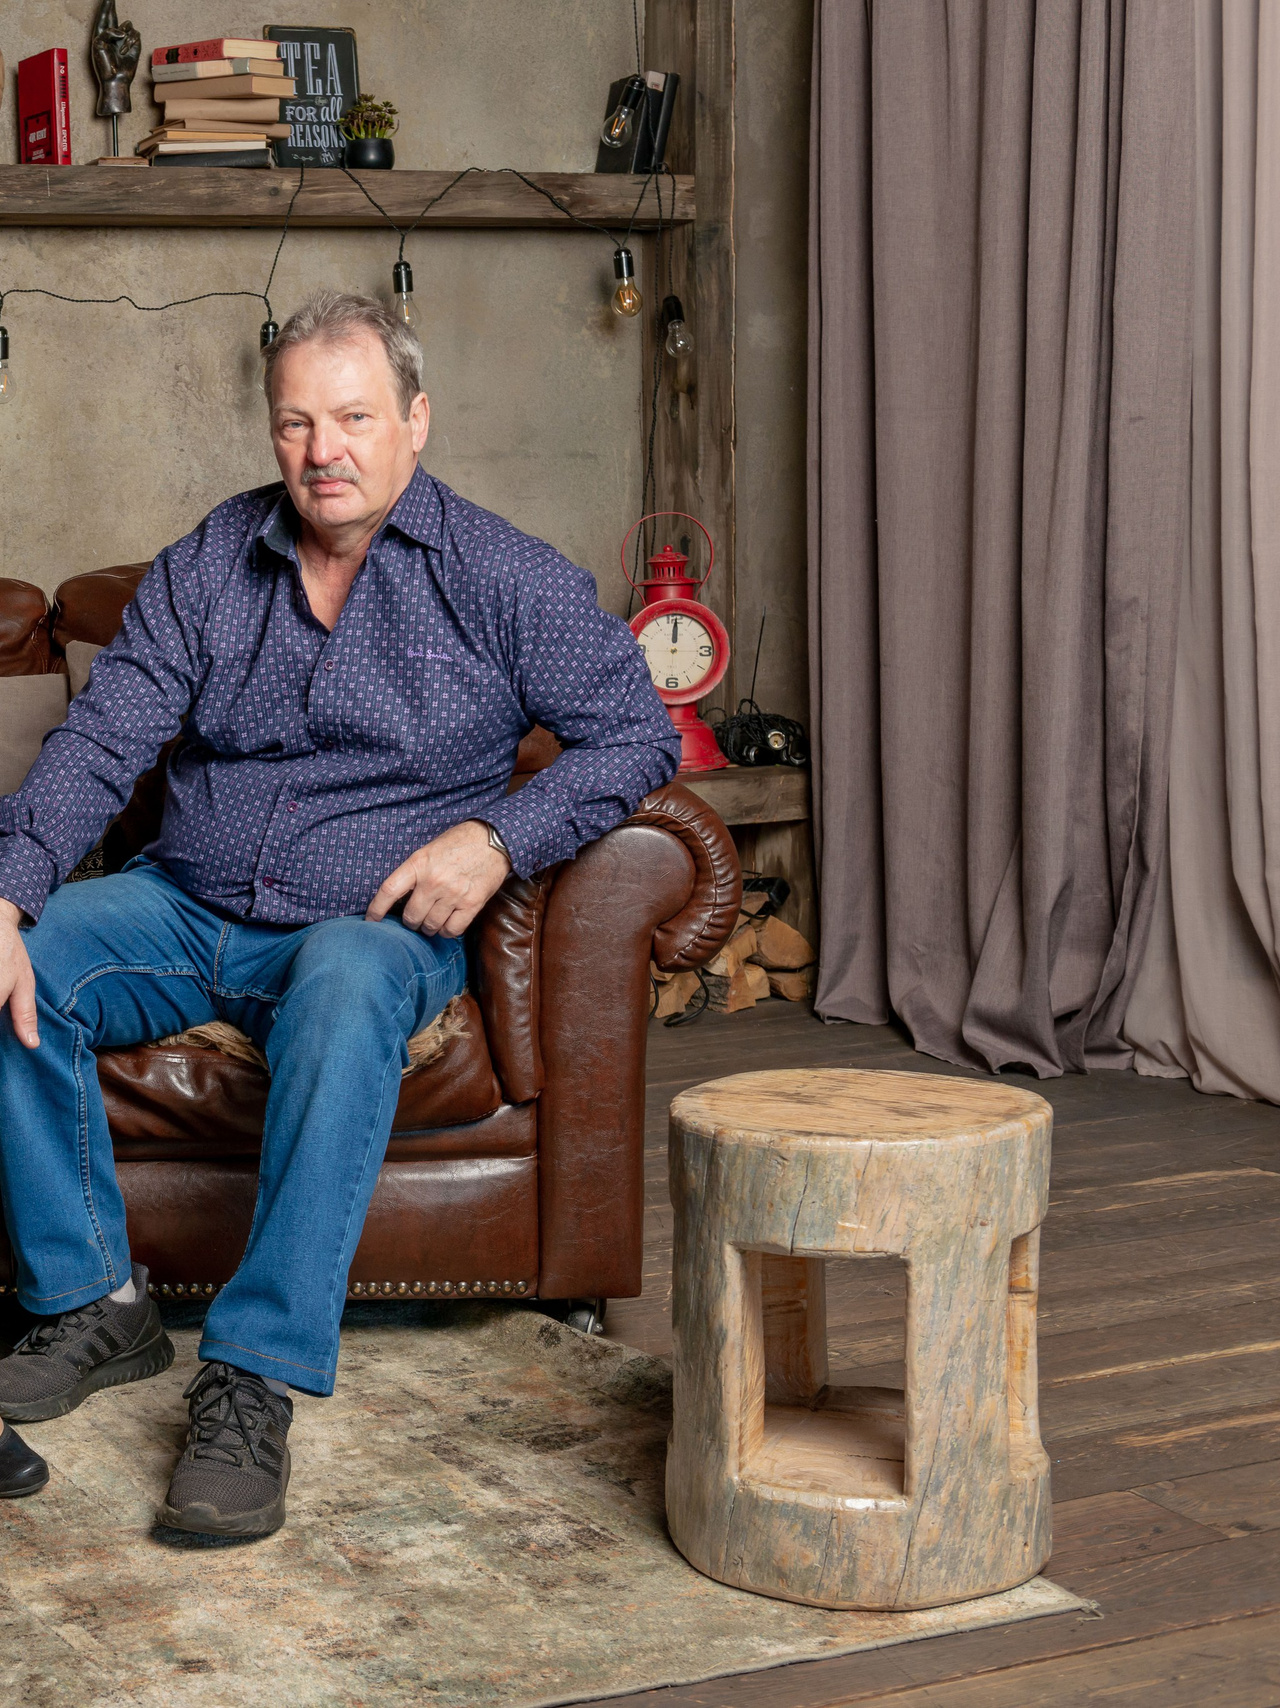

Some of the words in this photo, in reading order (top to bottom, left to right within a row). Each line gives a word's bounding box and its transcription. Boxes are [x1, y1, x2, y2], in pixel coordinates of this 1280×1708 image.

[280, 41, 344, 96] TEA
[285, 105, 318, 122] FOR
[320, 96, 342, 122] all
[287, 124, 347, 148] REASONS
[699, 645, 712, 657] 3
[665, 677, 679, 688] 6
